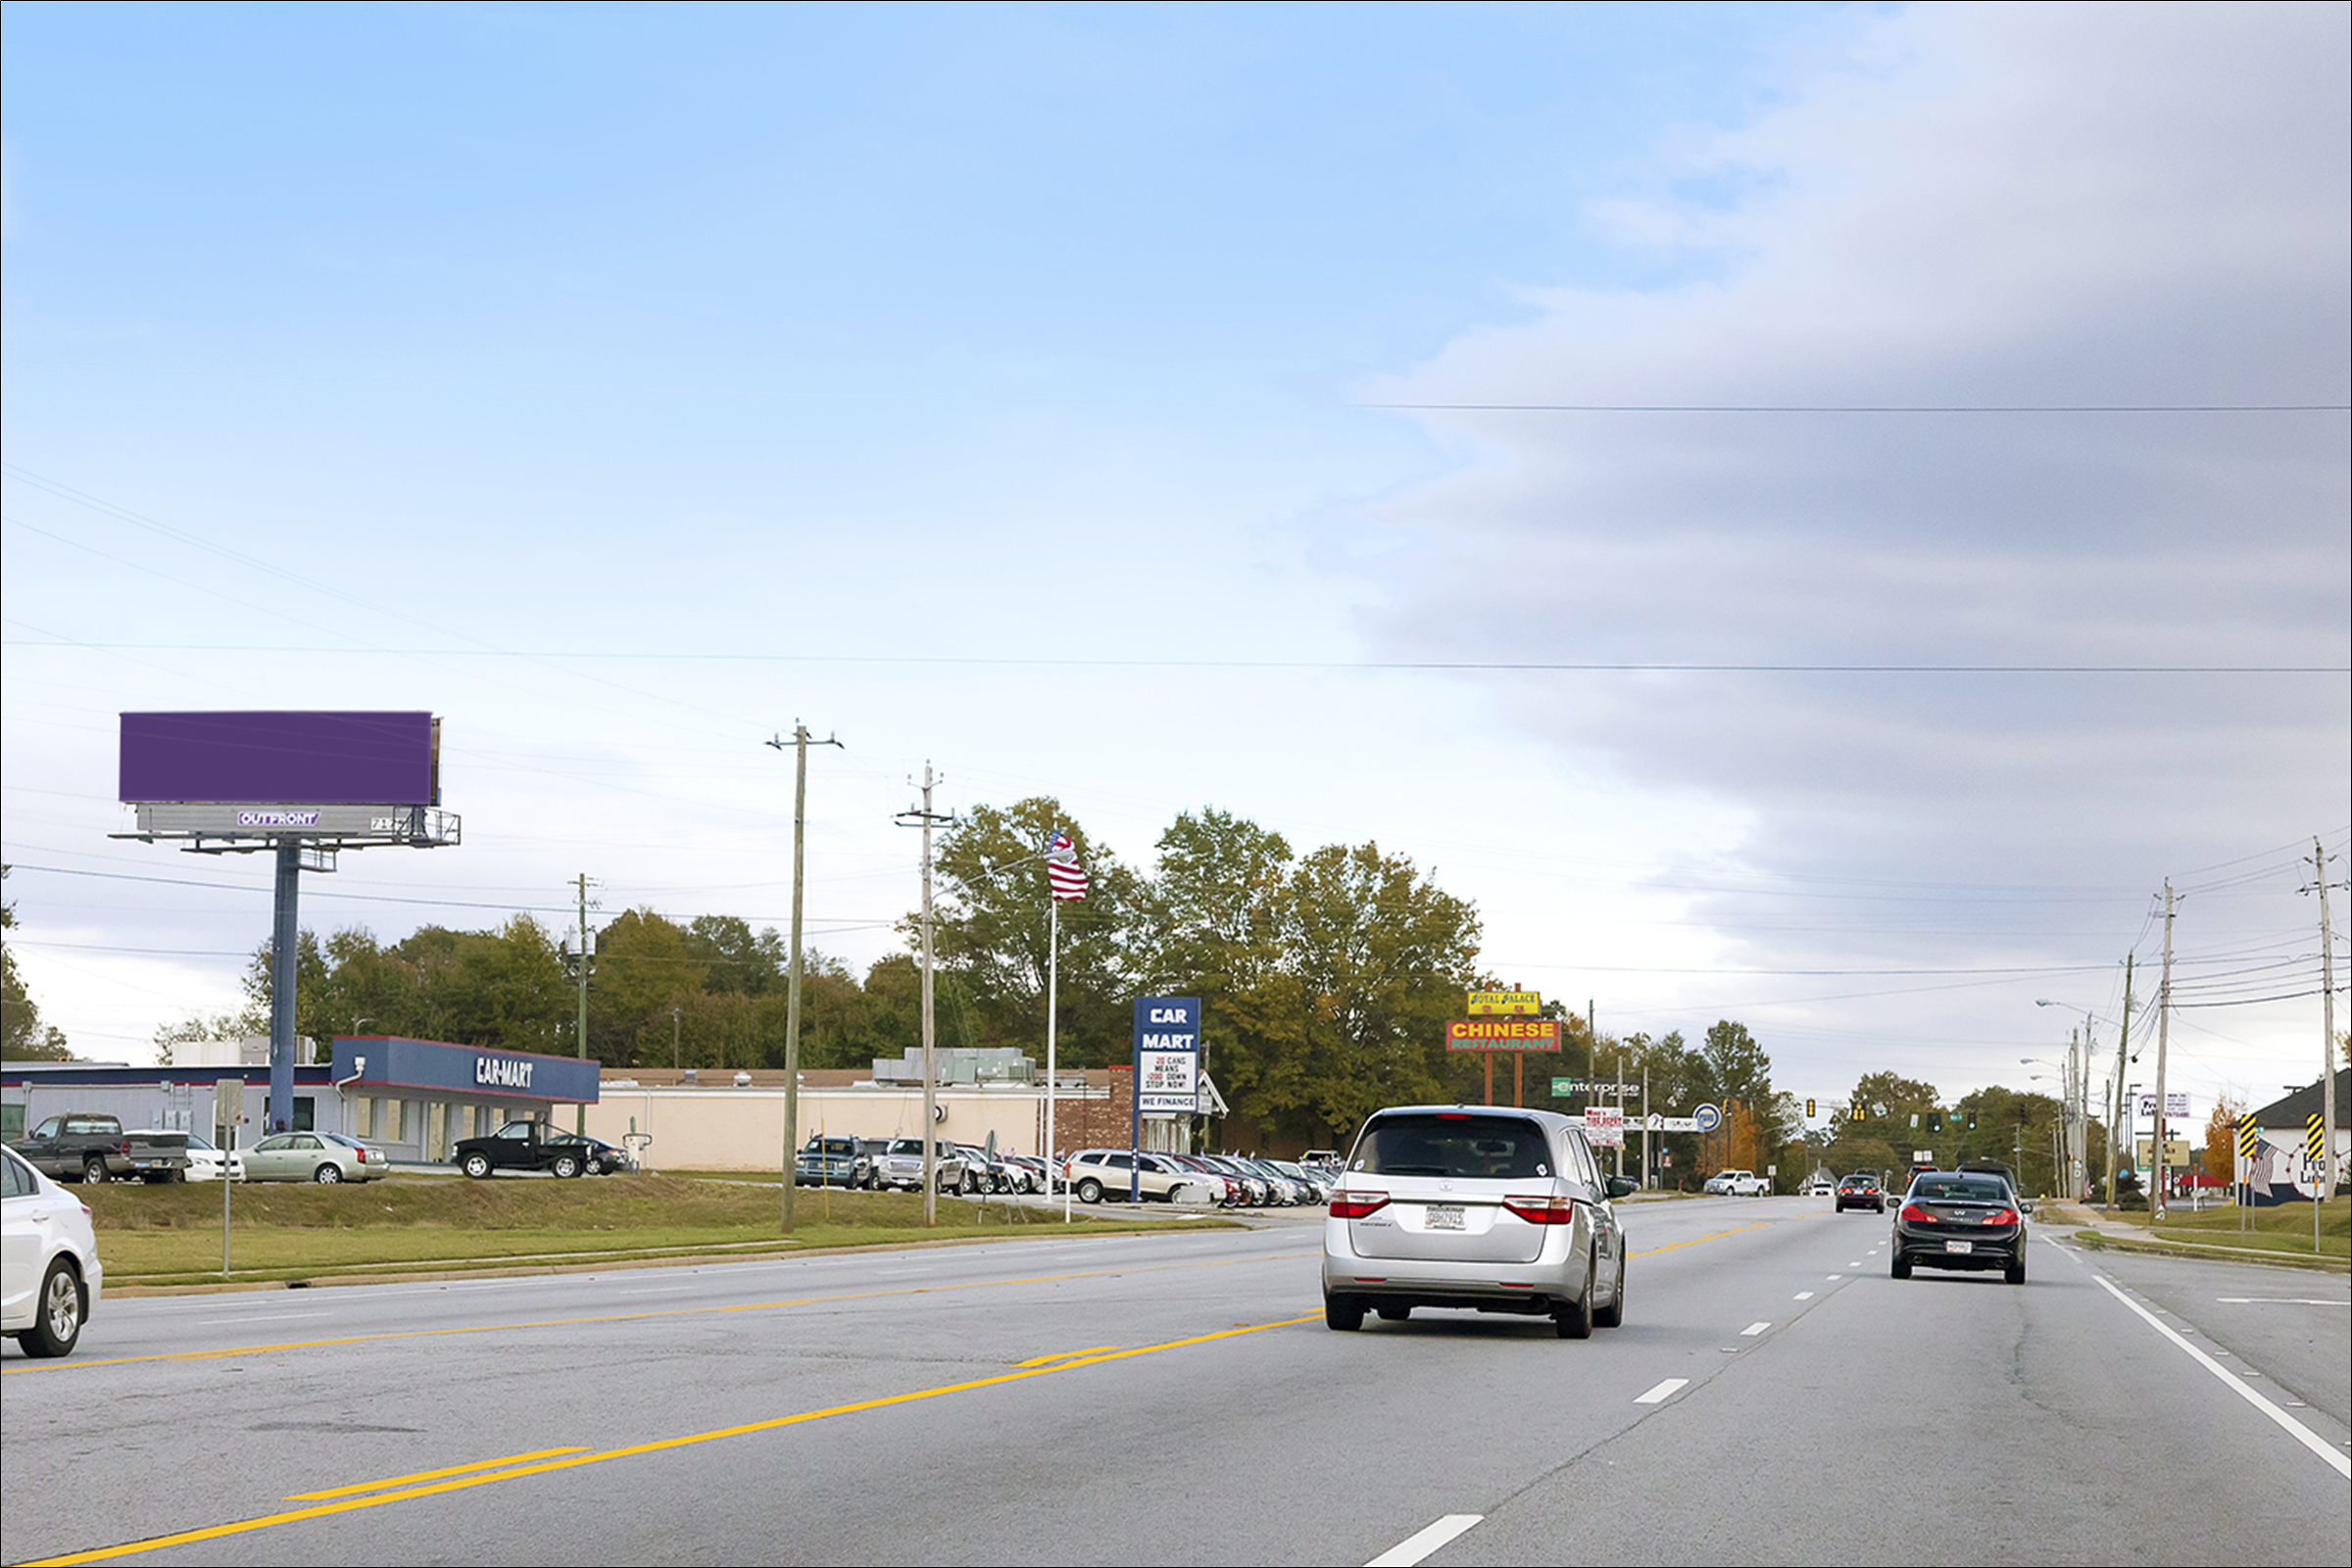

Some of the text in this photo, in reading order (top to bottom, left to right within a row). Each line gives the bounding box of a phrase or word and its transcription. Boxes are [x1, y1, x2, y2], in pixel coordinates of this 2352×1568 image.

[240, 812, 319, 825] OUTFRONT
[1150, 1008, 1187, 1024] CAR
[1452, 1023, 1554, 1038] CHINESE
[1143, 1034, 1195, 1050] MART
[1451, 1039, 1554, 1049] RESTAURANT
[1157, 1098, 1195, 1106] FINANCE
